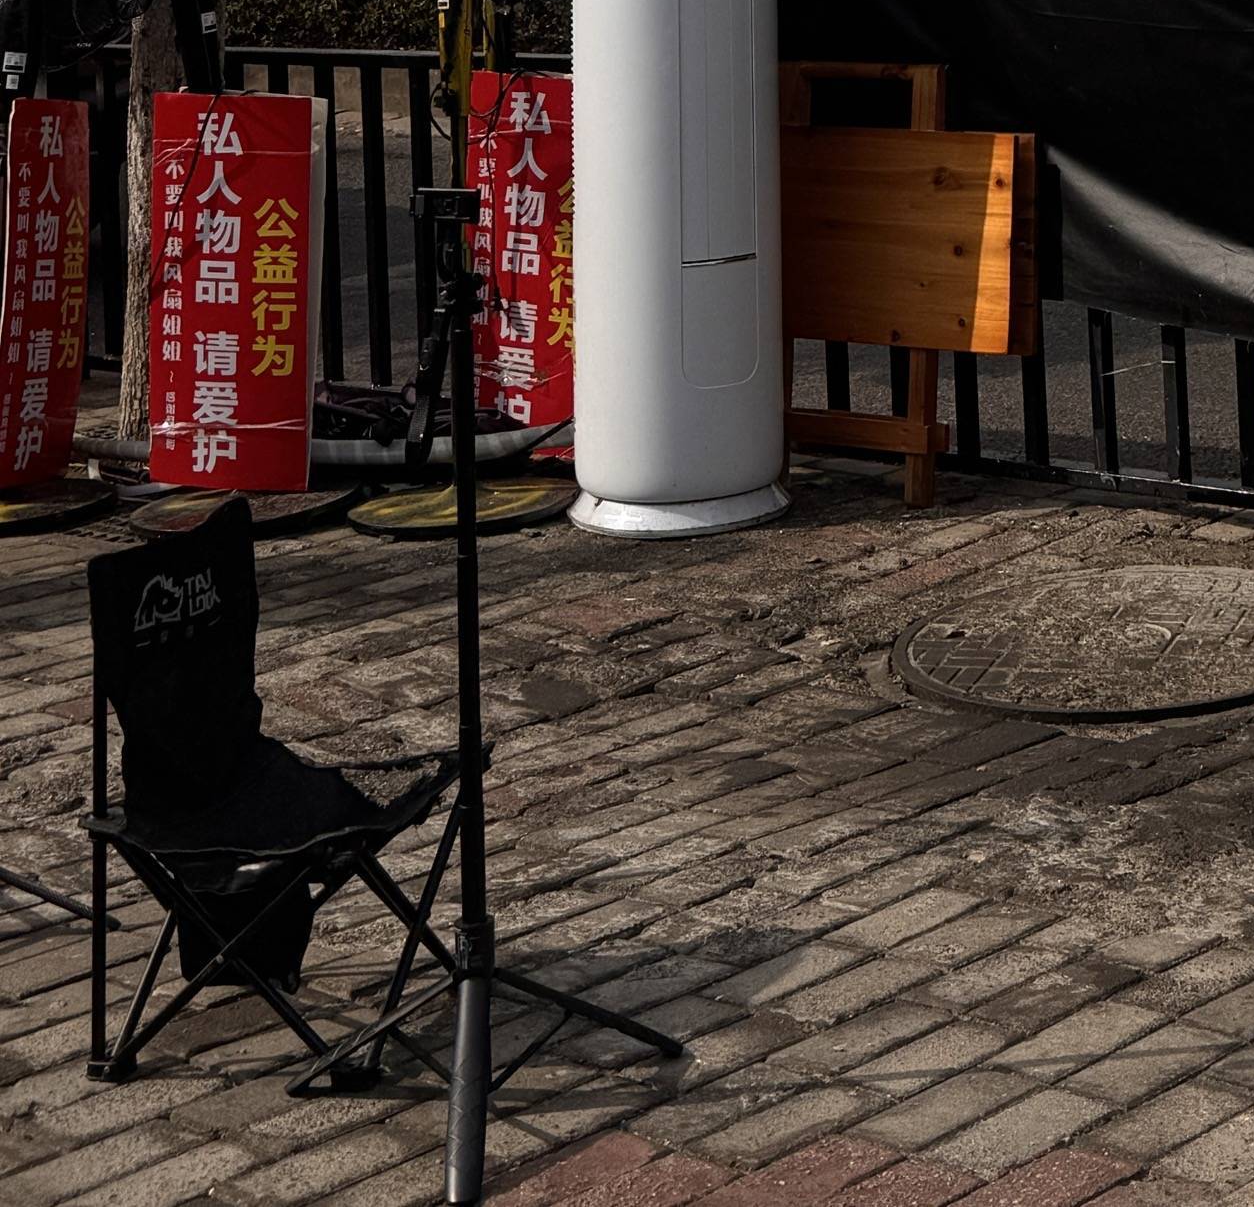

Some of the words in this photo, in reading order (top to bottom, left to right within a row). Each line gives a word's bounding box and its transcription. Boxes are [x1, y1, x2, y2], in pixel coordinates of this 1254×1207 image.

[31, 115, 63, 302] 私人物品
[195, 112, 243, 304] 私人物品
[501, 91, 551, 276] 私人物品
[56, 196, 87, 370] 公益行为
[251, 198, 300, 377] 公益行为
[13, 328, 54, 472] 请爱护
[191, 331, 240, 474] 请爱护
